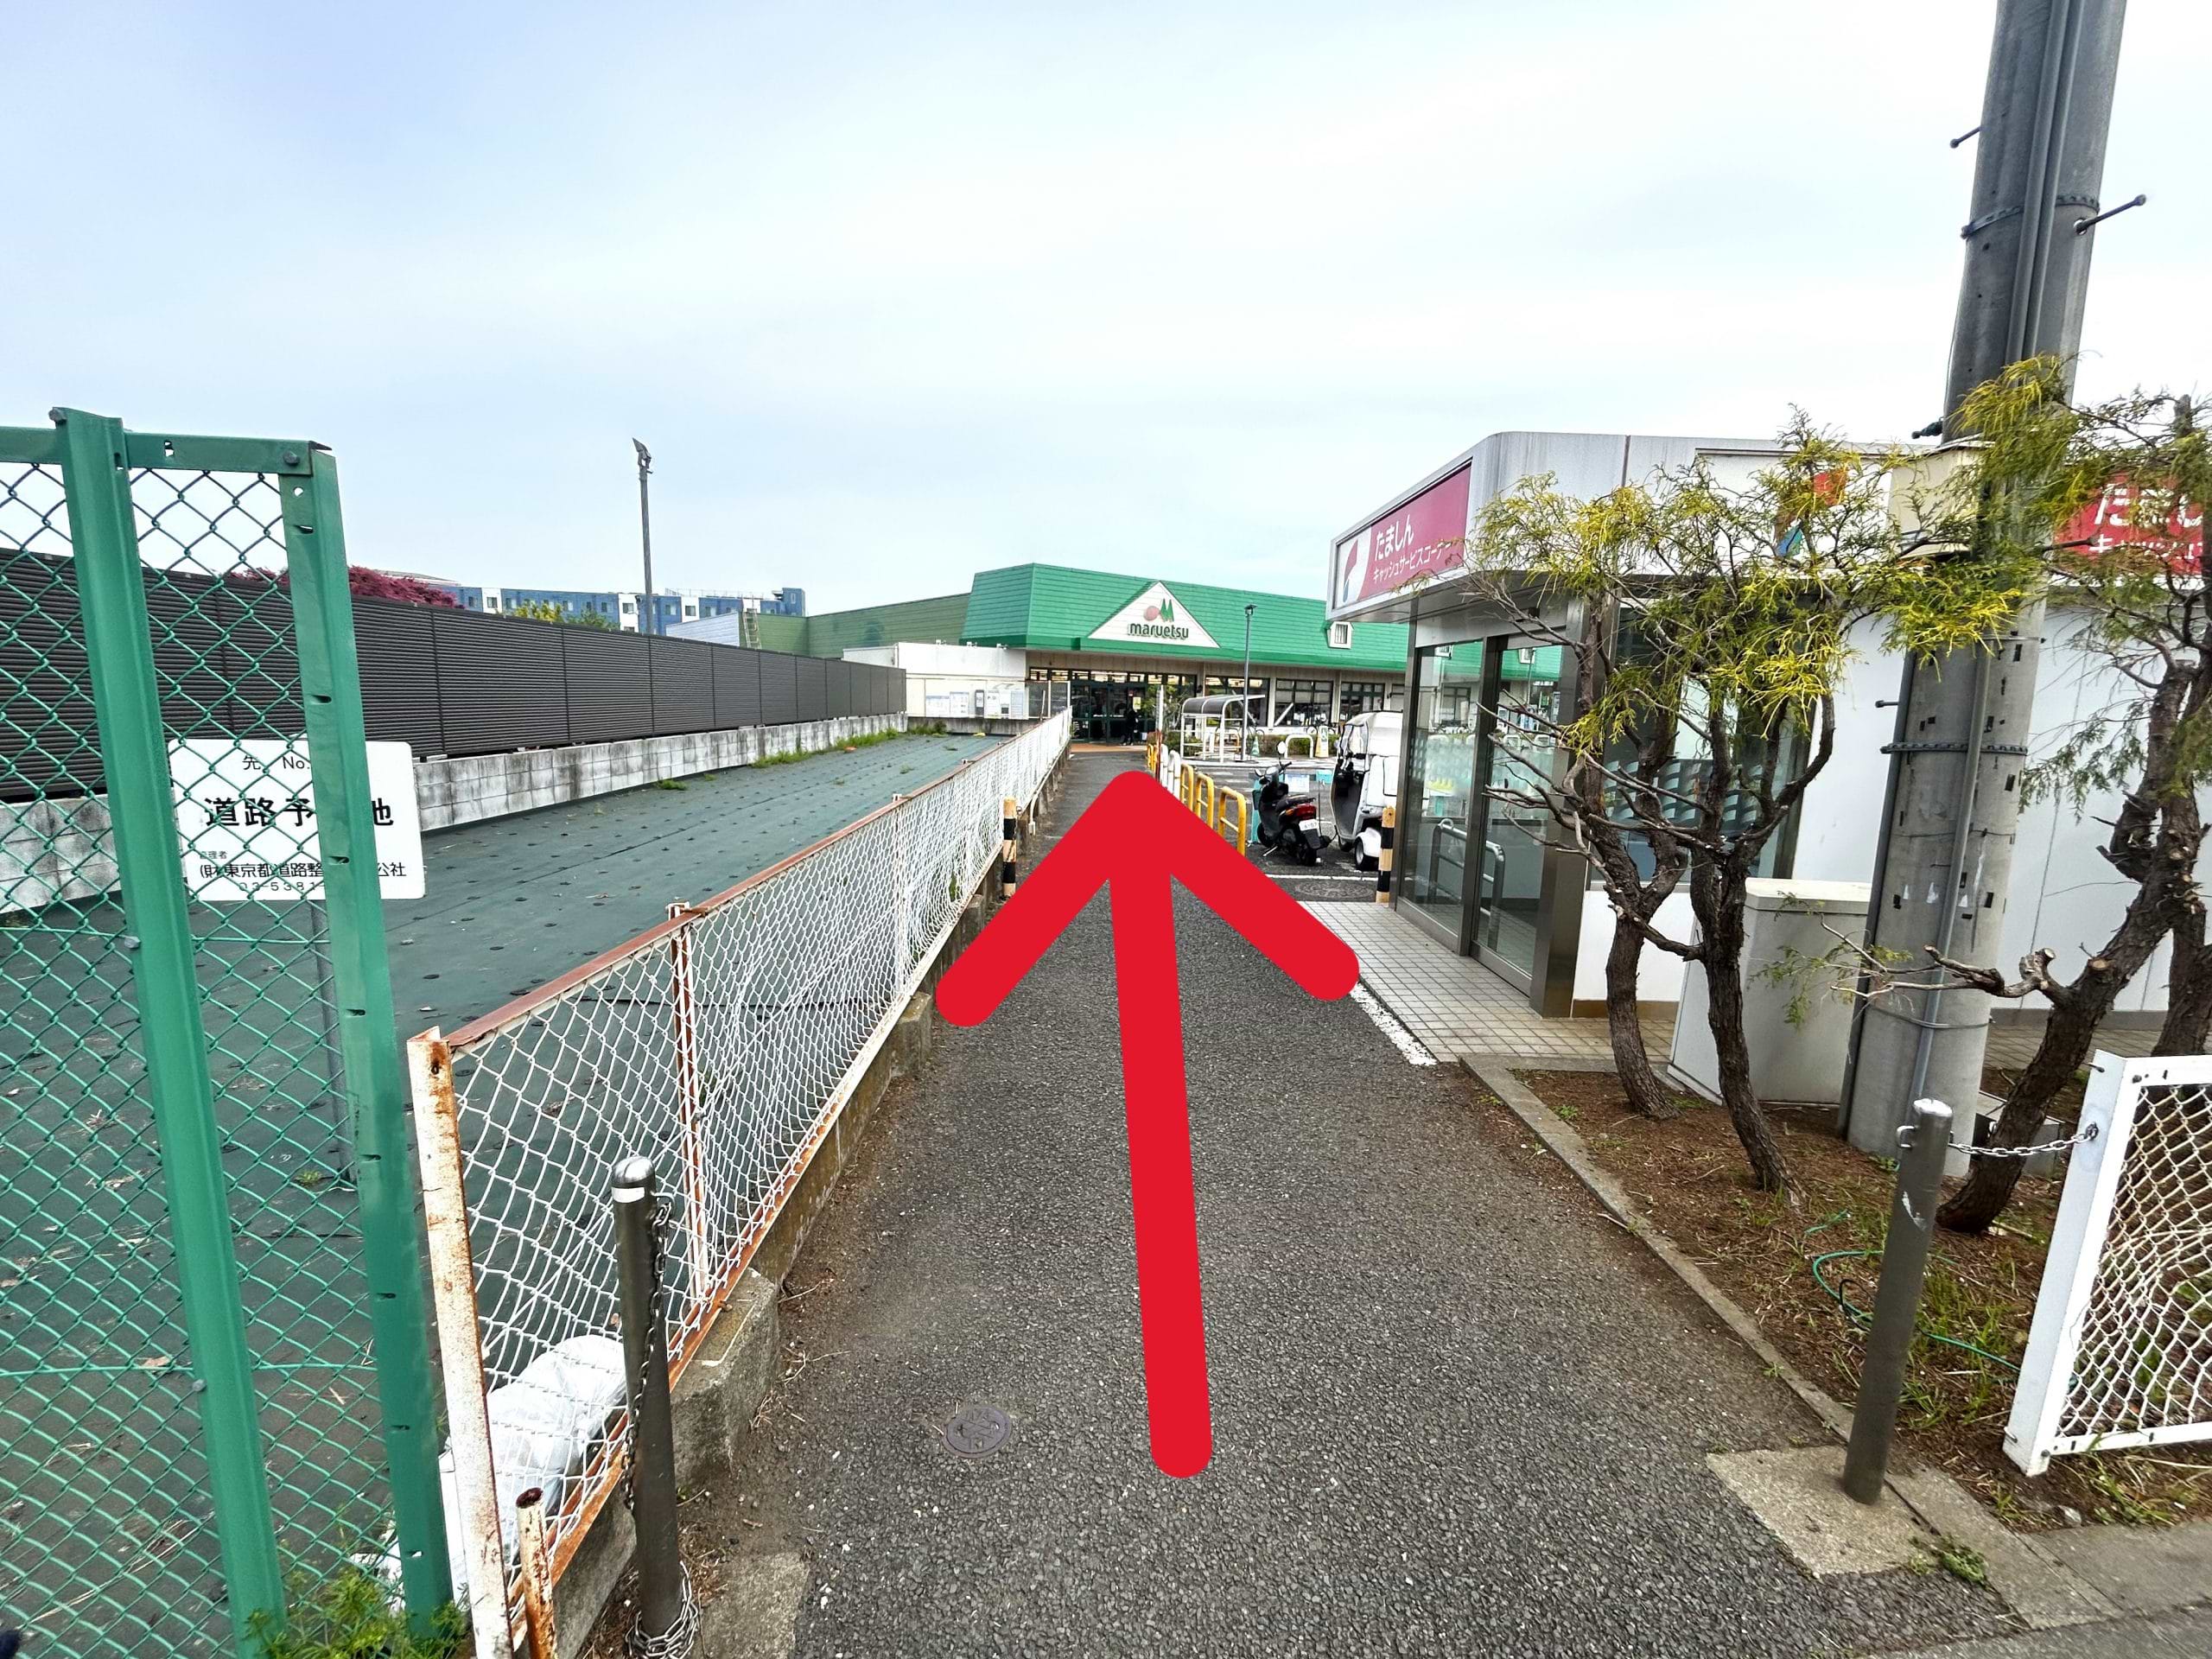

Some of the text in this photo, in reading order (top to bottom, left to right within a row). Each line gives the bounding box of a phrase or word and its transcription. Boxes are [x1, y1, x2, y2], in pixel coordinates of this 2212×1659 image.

[1374, 514, 1414, 562] たましん
[1372, 542, 1452, 585] キャッシュサービスコーナー
[1128, 623, 1189, 639] maruetsu
[204, 797, 395, 827] 道路予地
